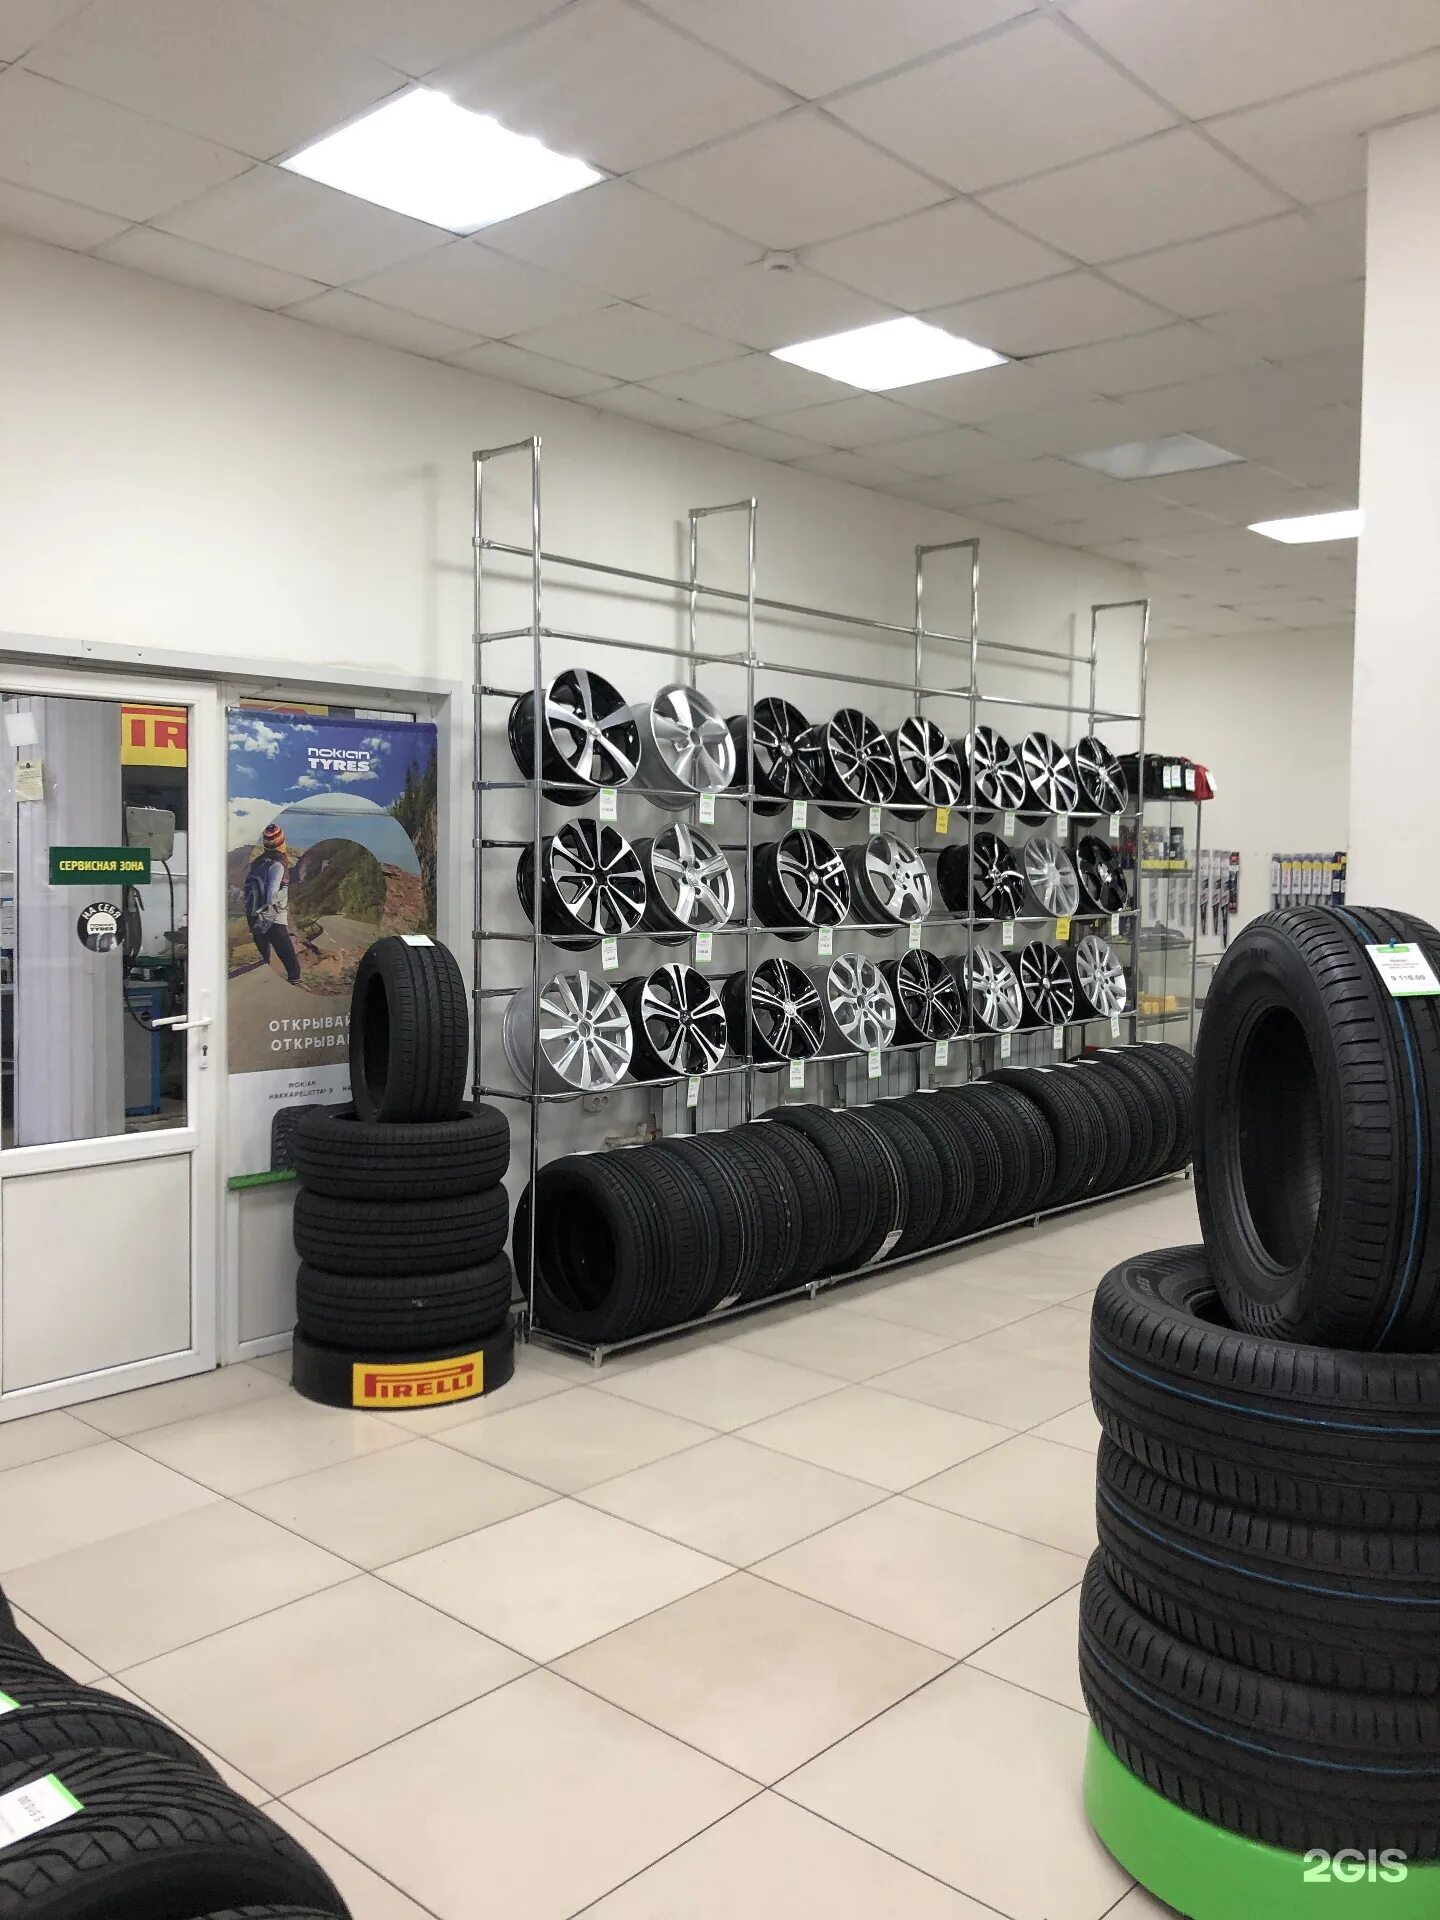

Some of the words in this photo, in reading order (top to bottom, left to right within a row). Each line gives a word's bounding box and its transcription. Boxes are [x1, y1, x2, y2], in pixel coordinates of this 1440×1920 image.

[307, 757, 370, 772] TYRES
[59, 860, 117, 871] СЕРВИСНАЯ
[119, 860, 145, 871] ЗОНА
[81, 906, 98, 920] НА
[97, 903, 122, 919] СЕБЯ
[364, 1363, 475, 1398] PIRELLI
